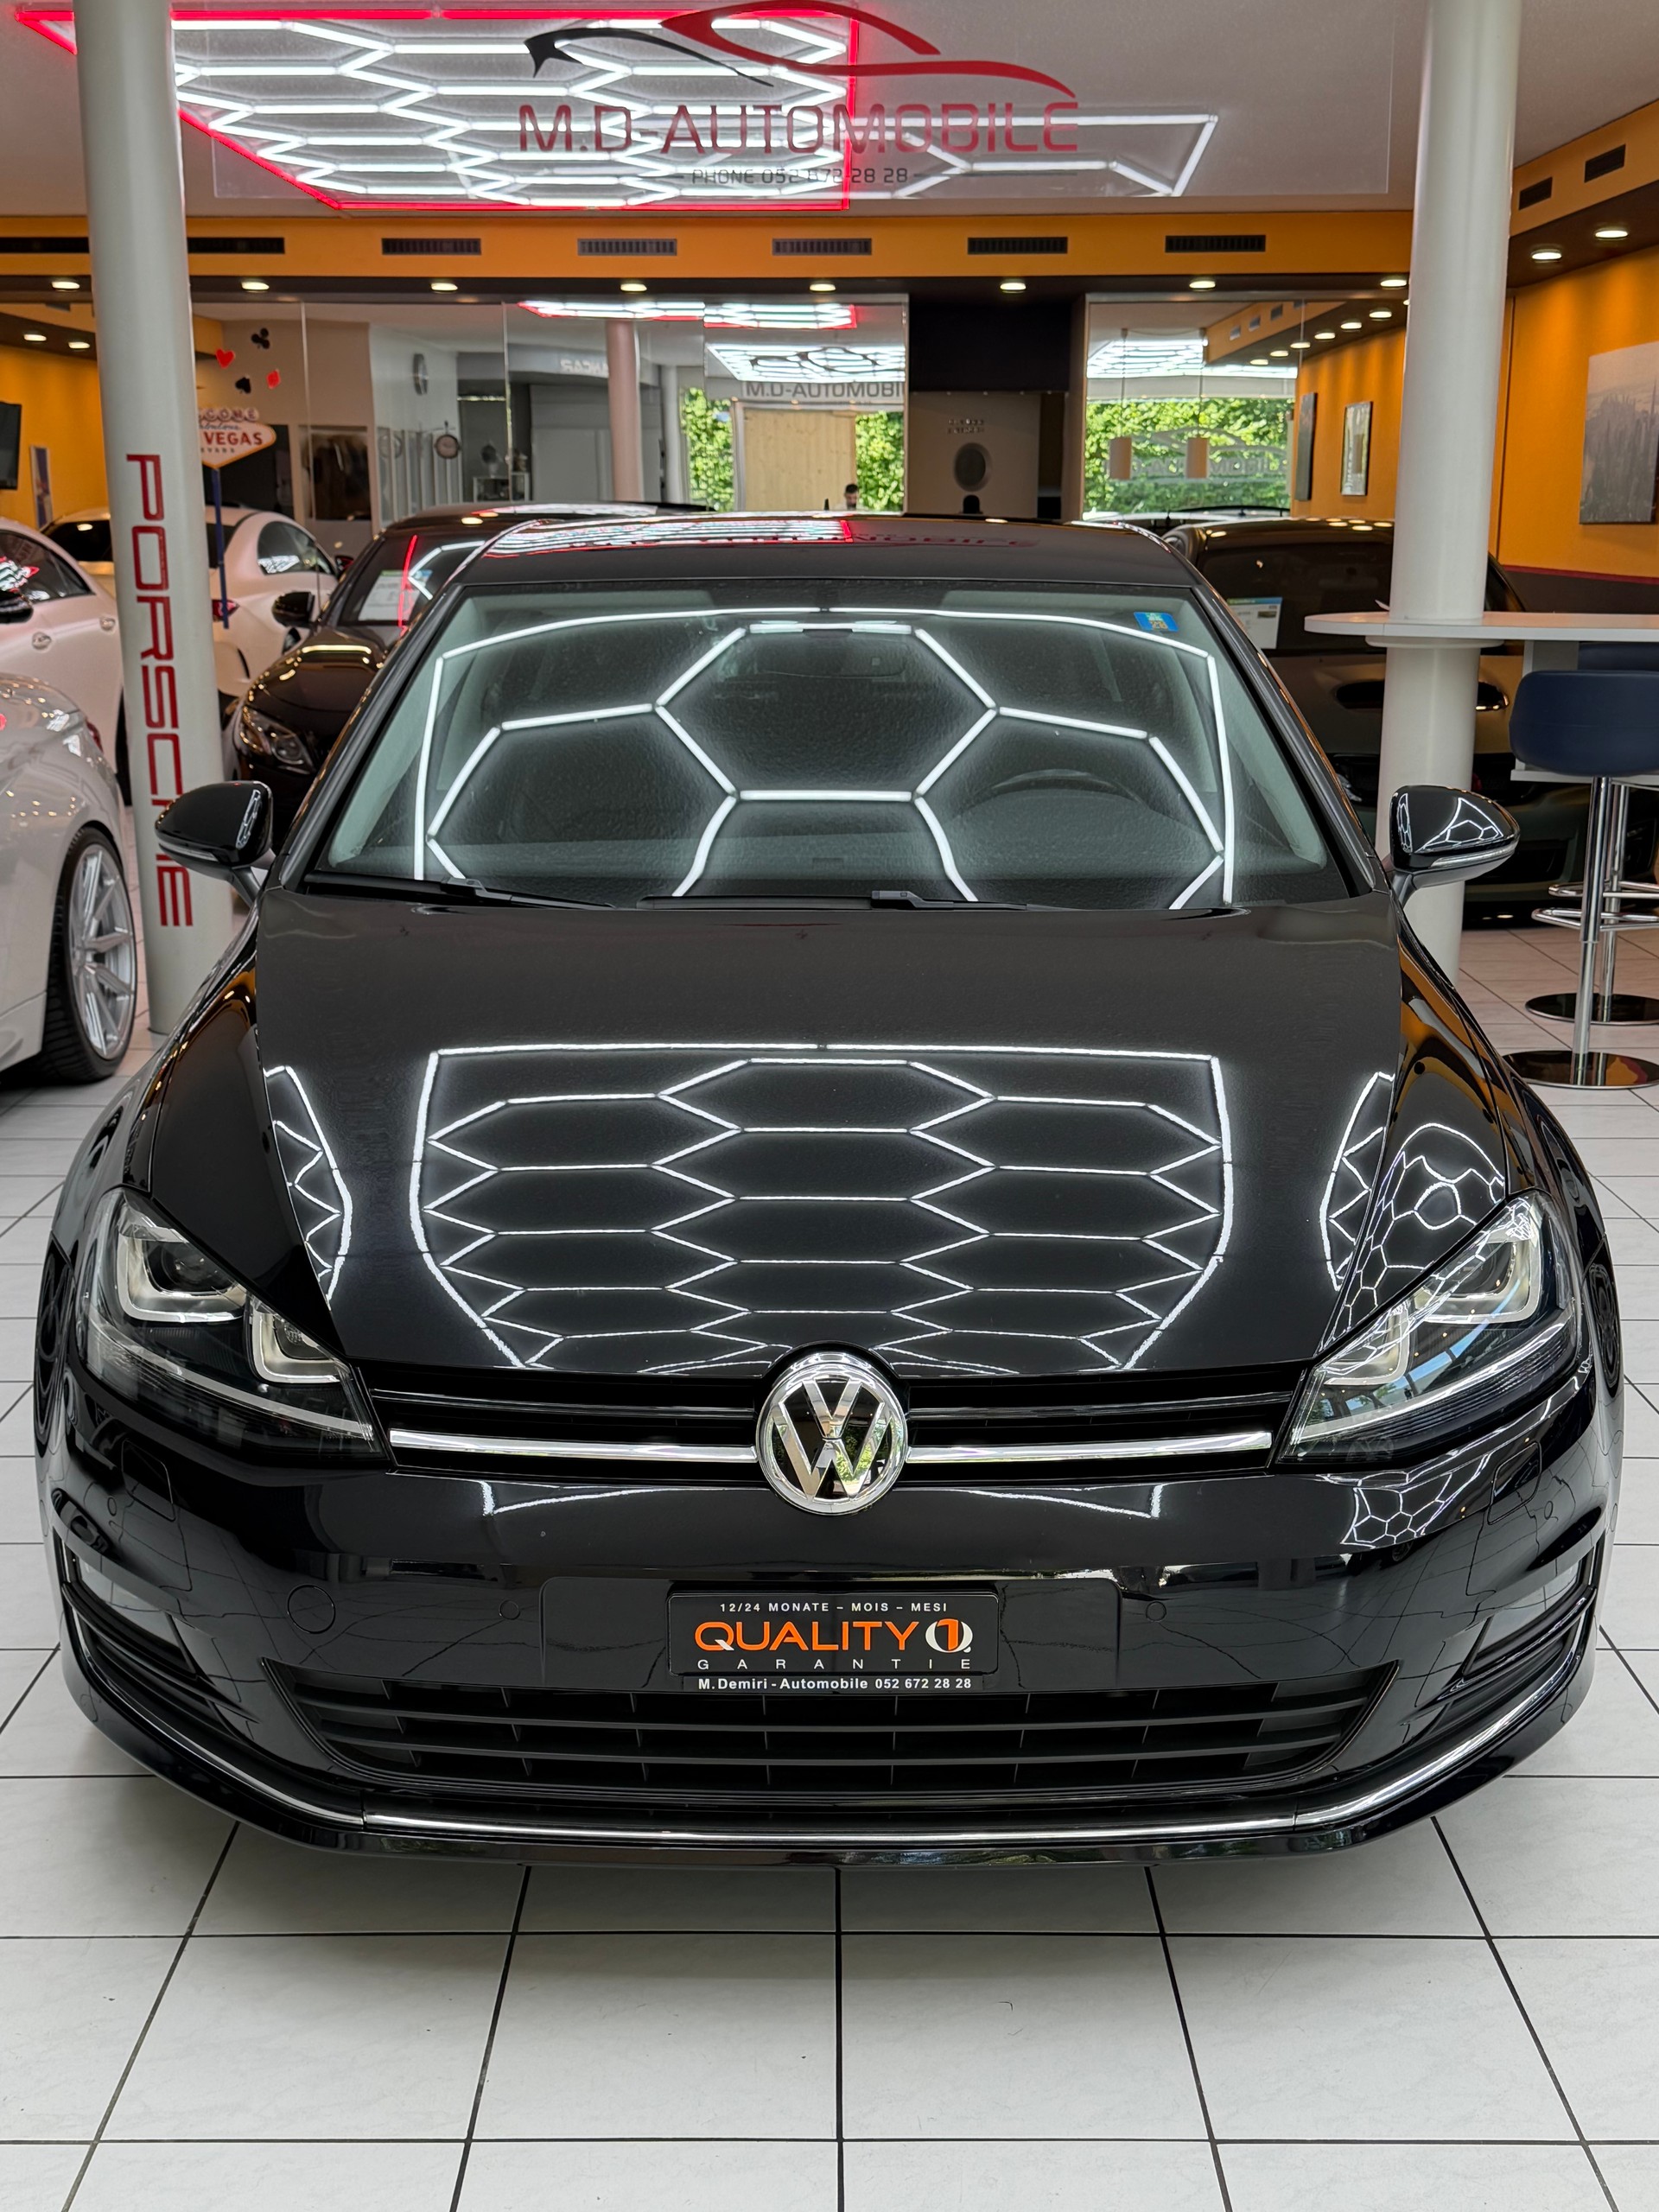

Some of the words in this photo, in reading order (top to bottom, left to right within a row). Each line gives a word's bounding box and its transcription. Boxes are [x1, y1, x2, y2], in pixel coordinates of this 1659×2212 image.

[692, 168, 754, 184] PHONE
[761, 168, 799, 184] 052
[851, 168, 875, 183] 28
[883, 168, 907, 183] 28
[746, 381, 904, 398] M.D-AUTOMOBI
[203, 431, 263, 446] VEGAS
[126, 454, 194, 927] PORSCE
[720, 1603, 760, 1612] 12/24
[768, 1602, 830, 1612] MONATE
[851, 1602, 889, 1612] MOIS
[911, 1602, 947, 1612] MESI
[695, 1621, 919, 1651] QUALITY
[697, 1658, 970, 1670] GARANTIE
[779, 1677, 868, 1689] Automobile
[874, 1678, 899, 1689] 052
[905, 1678, 929, 1689] 672
[934, 1678, 950, 1689] 28
[955, 1678, 971, 1689] 28
